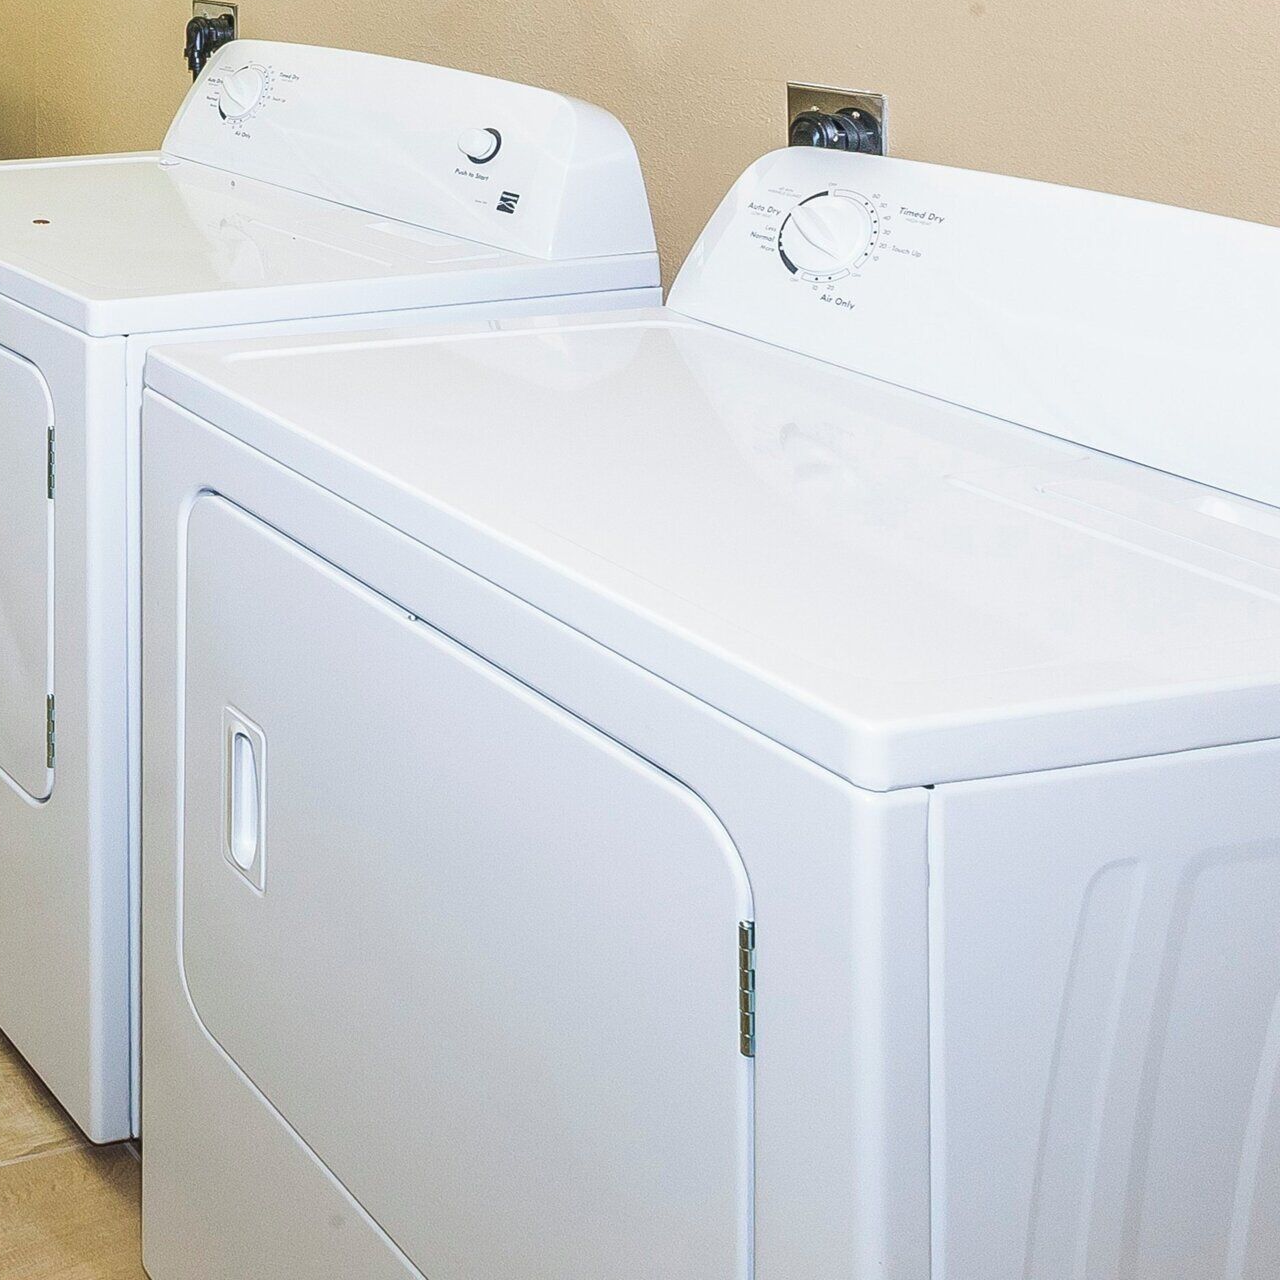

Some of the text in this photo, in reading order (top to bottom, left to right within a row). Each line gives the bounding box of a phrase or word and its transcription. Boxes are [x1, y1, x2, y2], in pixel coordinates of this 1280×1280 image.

[454, 167, 468, 176] Push
[747, 201, 765, 212] Auto
[766, 205, 782, 216] Dry
[899, 206, 927, 220] Timed
[927, 212, 945, 224] Dry
[749, 230, 776, 243] Normal
[819, 293, 856, 310] Air Only
